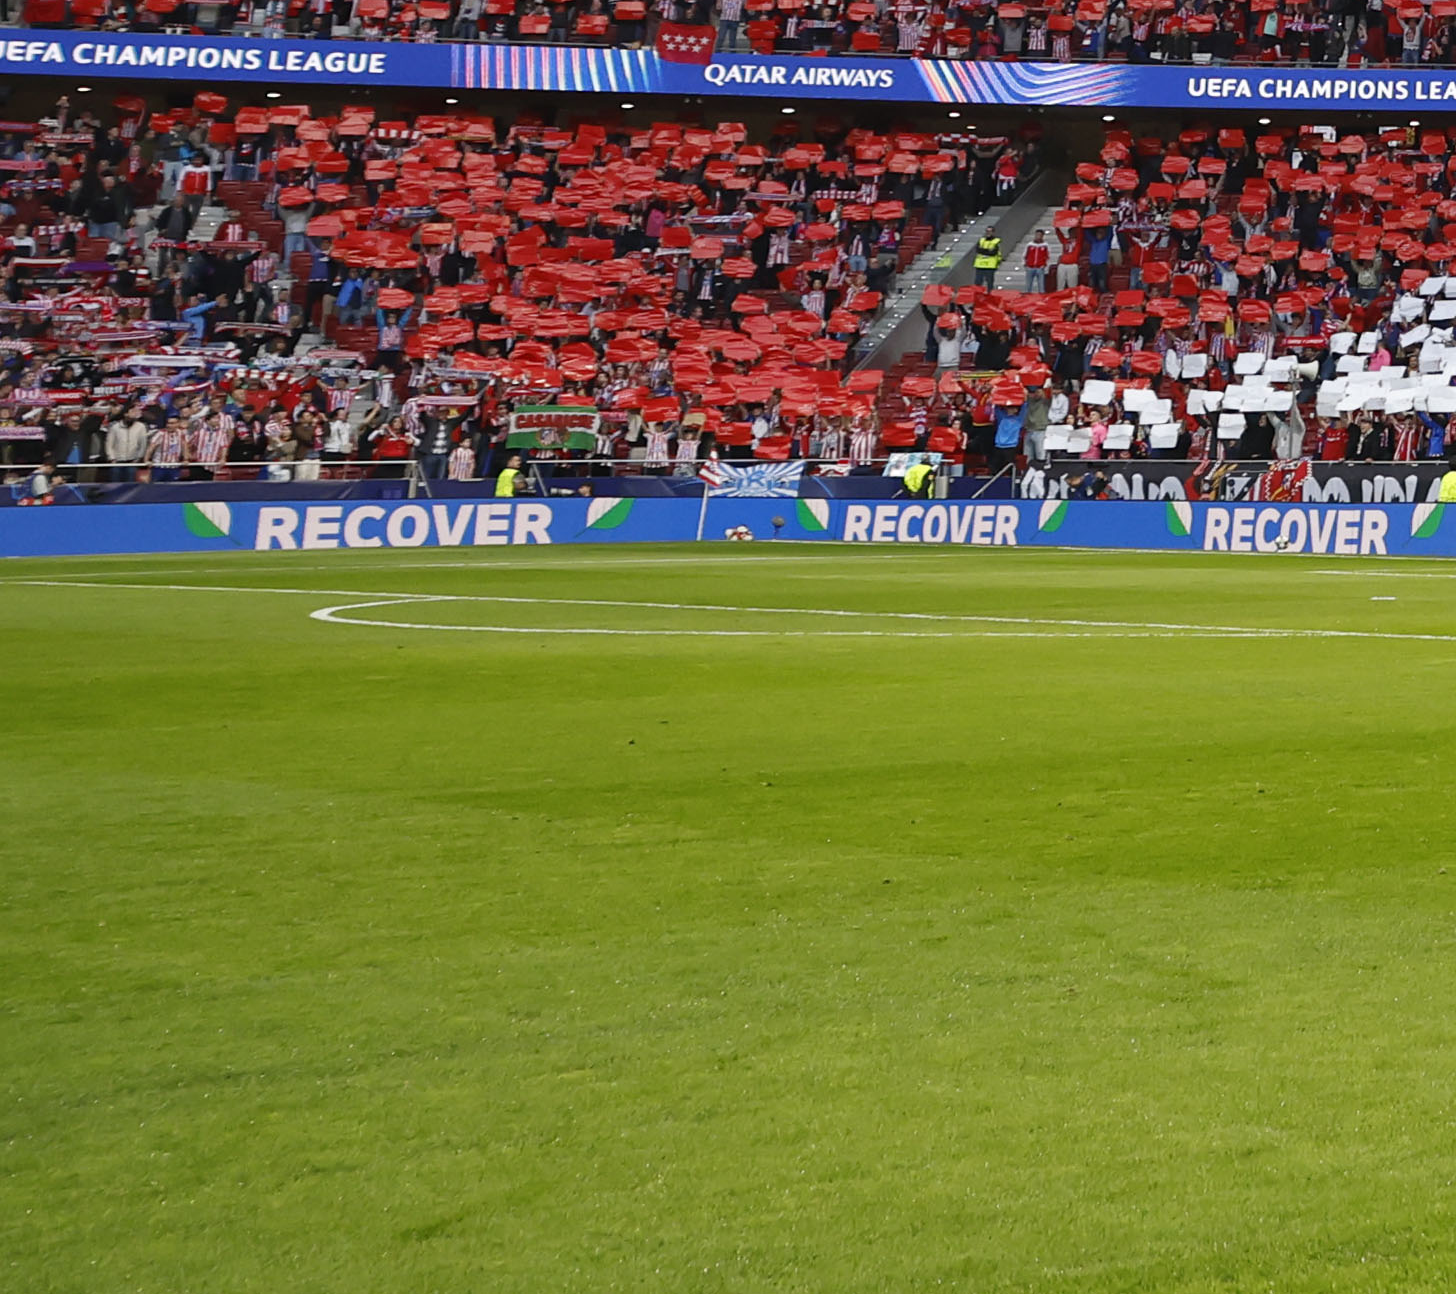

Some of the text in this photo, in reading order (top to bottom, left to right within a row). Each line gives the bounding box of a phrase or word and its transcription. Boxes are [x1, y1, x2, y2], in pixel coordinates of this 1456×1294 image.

[72, 43, 281, 71] CHAMPIONS
[285, 51, 386, 74] LEAGUE
[704, 63, 893, 88] QATAR AIRWAYS
[1188, 78, 1252, 98] UEFA
[1258, 78, 1409, 100] CHAMPIONS
[255, 504, 553, 551] RECOVER
[843, 505, 1019, 546] RECOVER
[1203, 507, 1388, 555] RECOVER
